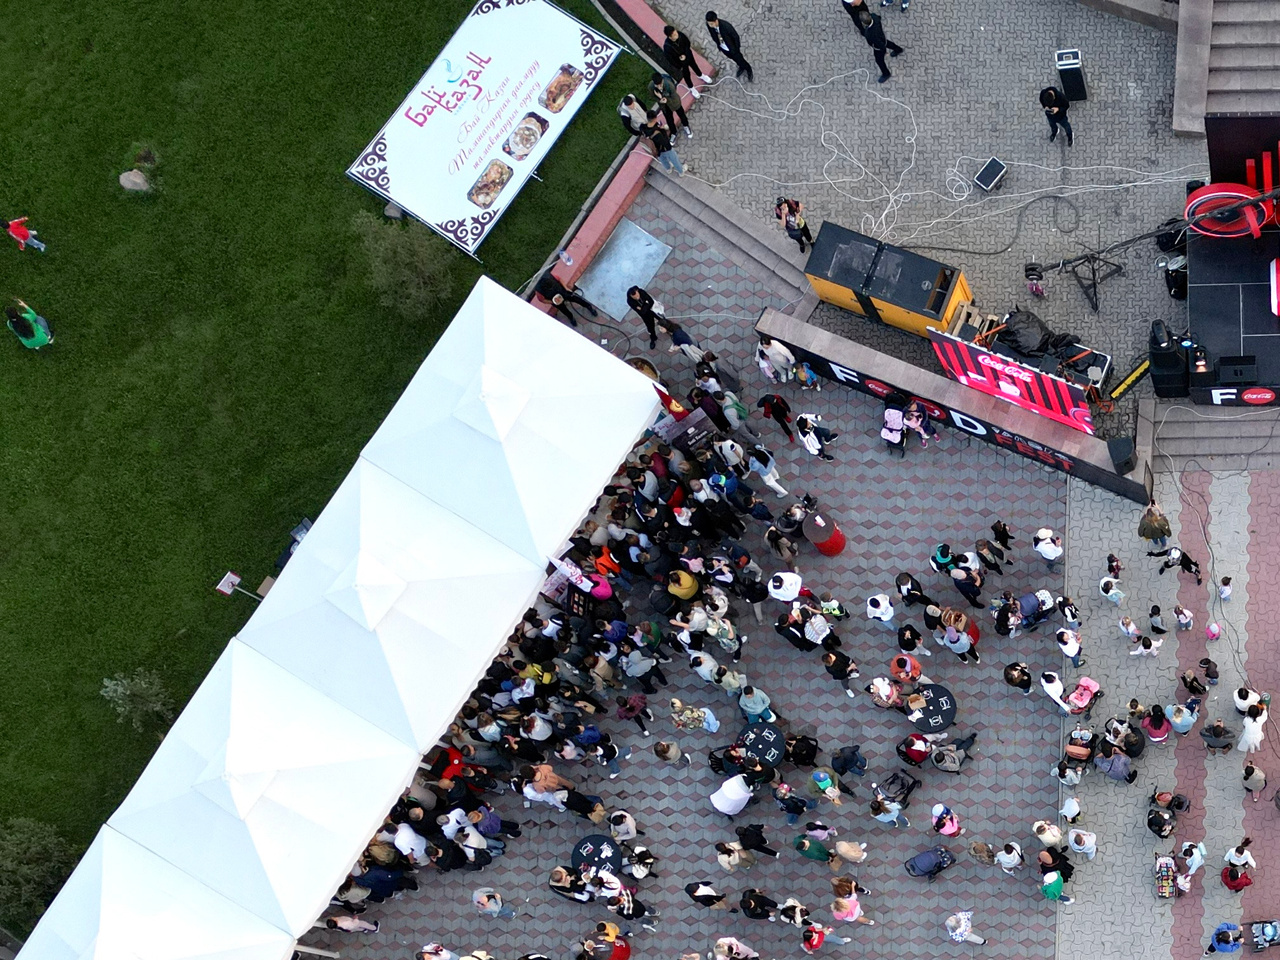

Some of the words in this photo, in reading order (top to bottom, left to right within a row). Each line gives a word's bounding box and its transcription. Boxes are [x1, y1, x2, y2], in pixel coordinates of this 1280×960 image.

[456, 114, 482, 143] Бай
[477, 77, 510, 113] Казан
[471, 107, 519, 169] тамактардын
[519, 80, 541, 108] ордосу
[994, 433, 1075, 471] FEST
